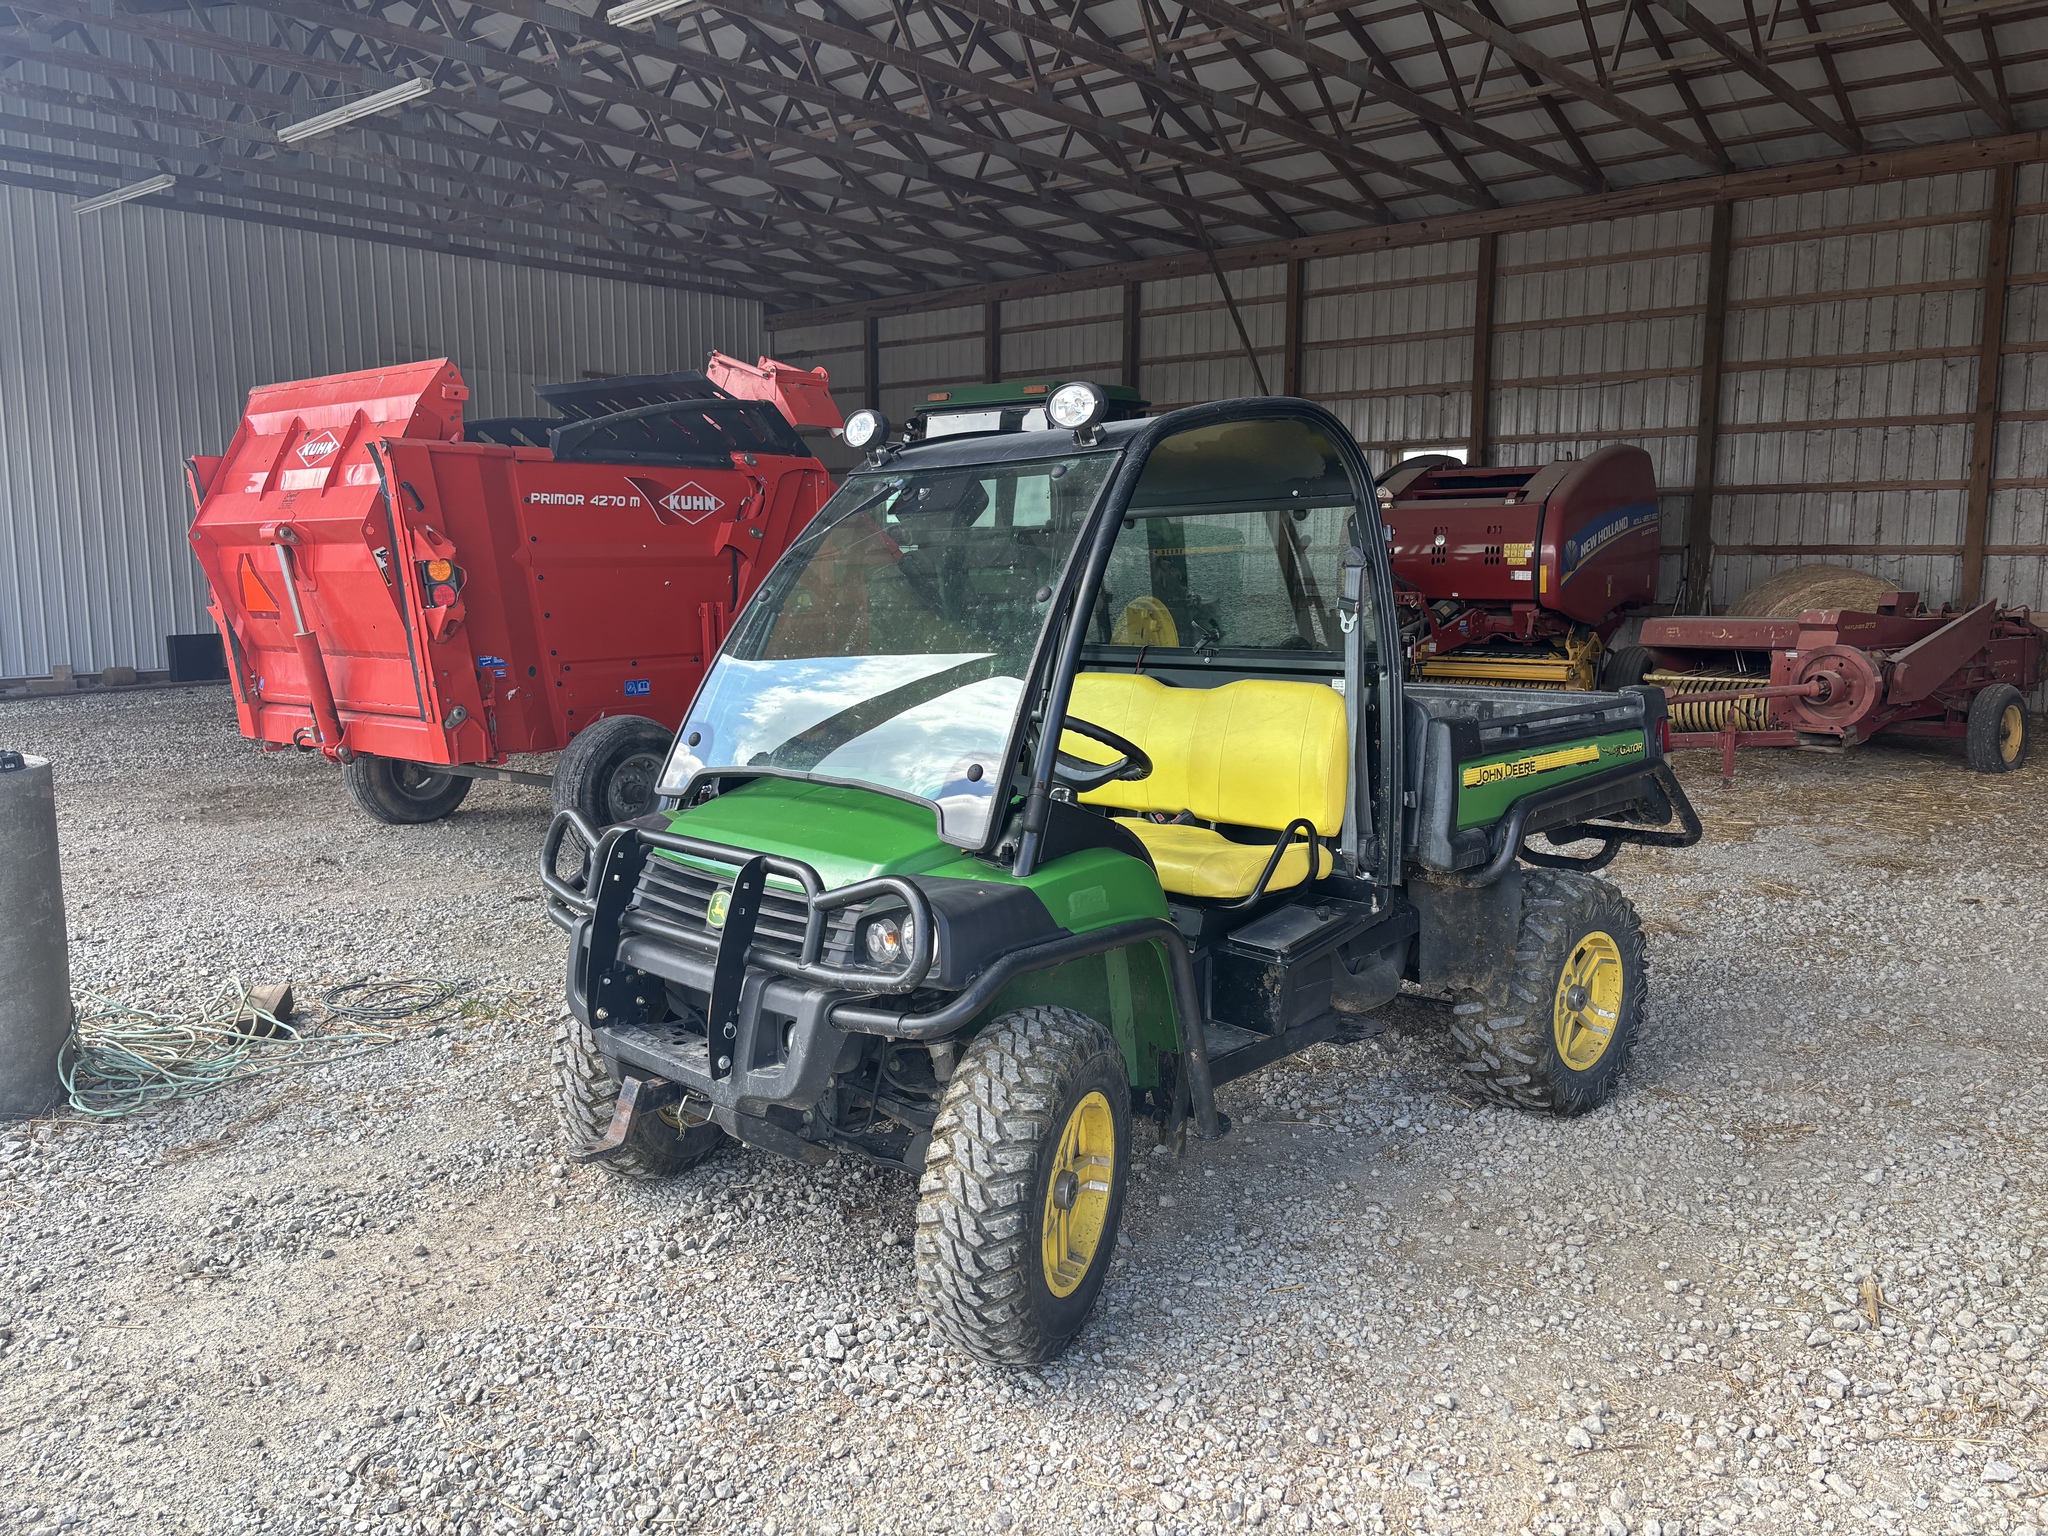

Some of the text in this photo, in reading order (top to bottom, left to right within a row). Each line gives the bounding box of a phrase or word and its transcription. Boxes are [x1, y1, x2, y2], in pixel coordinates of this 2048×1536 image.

[302, 441, 336, 456] KUHN
[530, 492, 640, 507] PRIMOR 4270 M
[669, 494, 716, 511] KUHN
[1580, 533, 1597, 558] NEW
[1598, 516, 1628, 544] HOLLAND
[1865, 621, 1877, 629] 273
[1619, 742, 1643, 755] GATOR
[1476, 761, 1536, 784] JOHN DEERE
